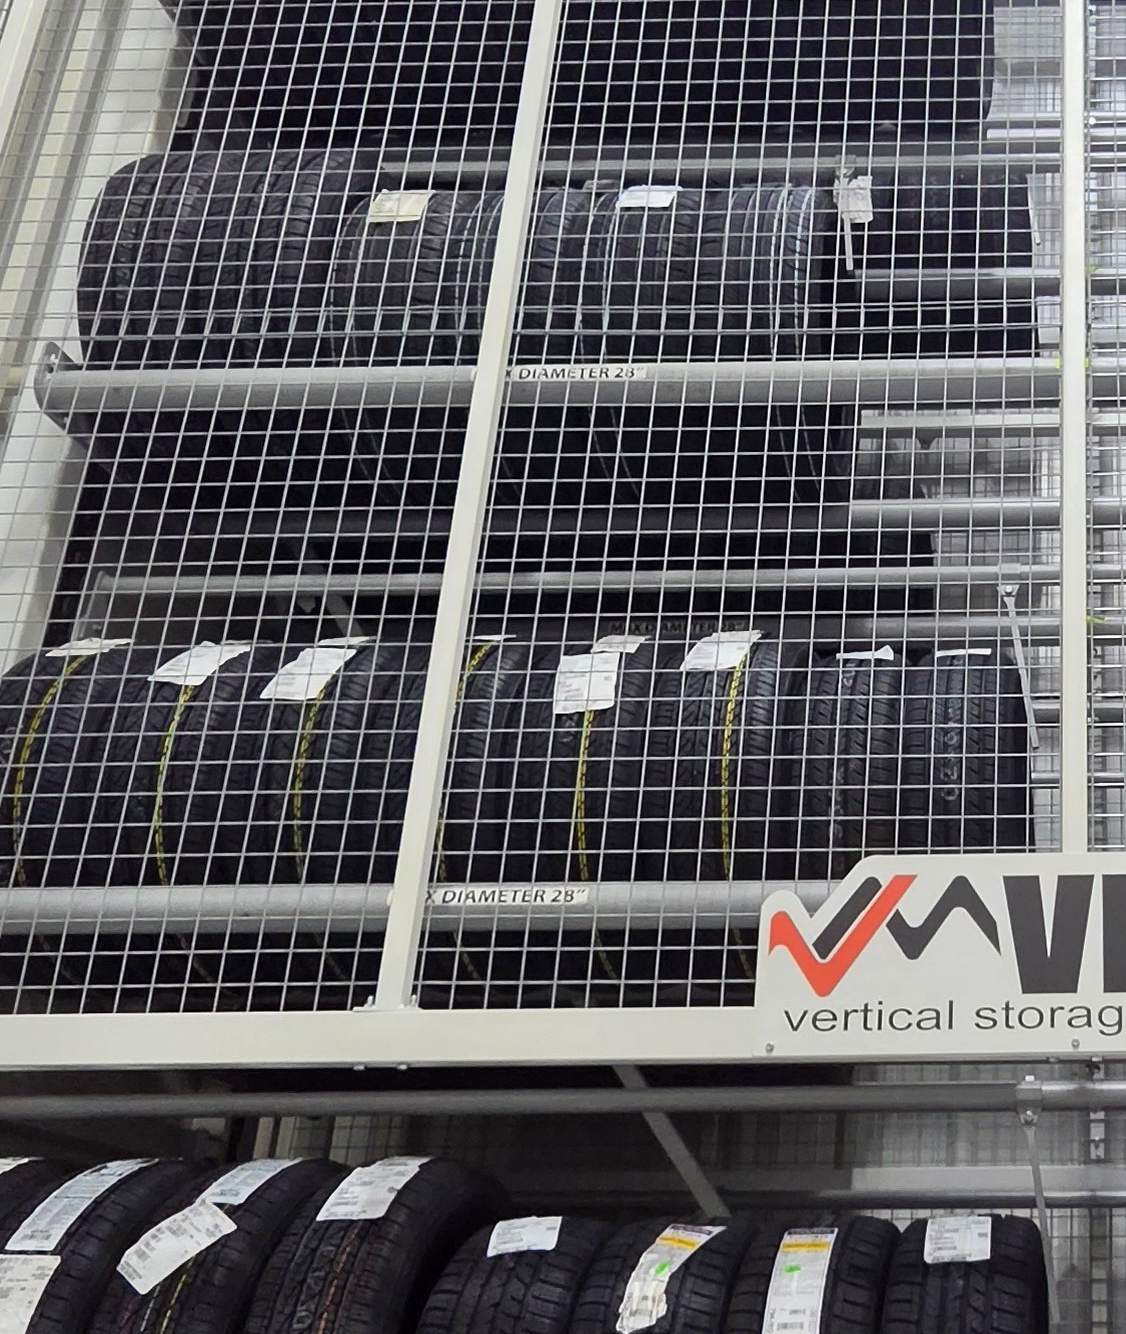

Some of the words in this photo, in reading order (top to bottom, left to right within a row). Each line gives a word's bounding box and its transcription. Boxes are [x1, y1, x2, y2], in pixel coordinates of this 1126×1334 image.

[518, 367, 609, 380] DIAMETER
[442, 889, 546, 904] DIAMETER
[783, 999, 956, 1034] vertical
